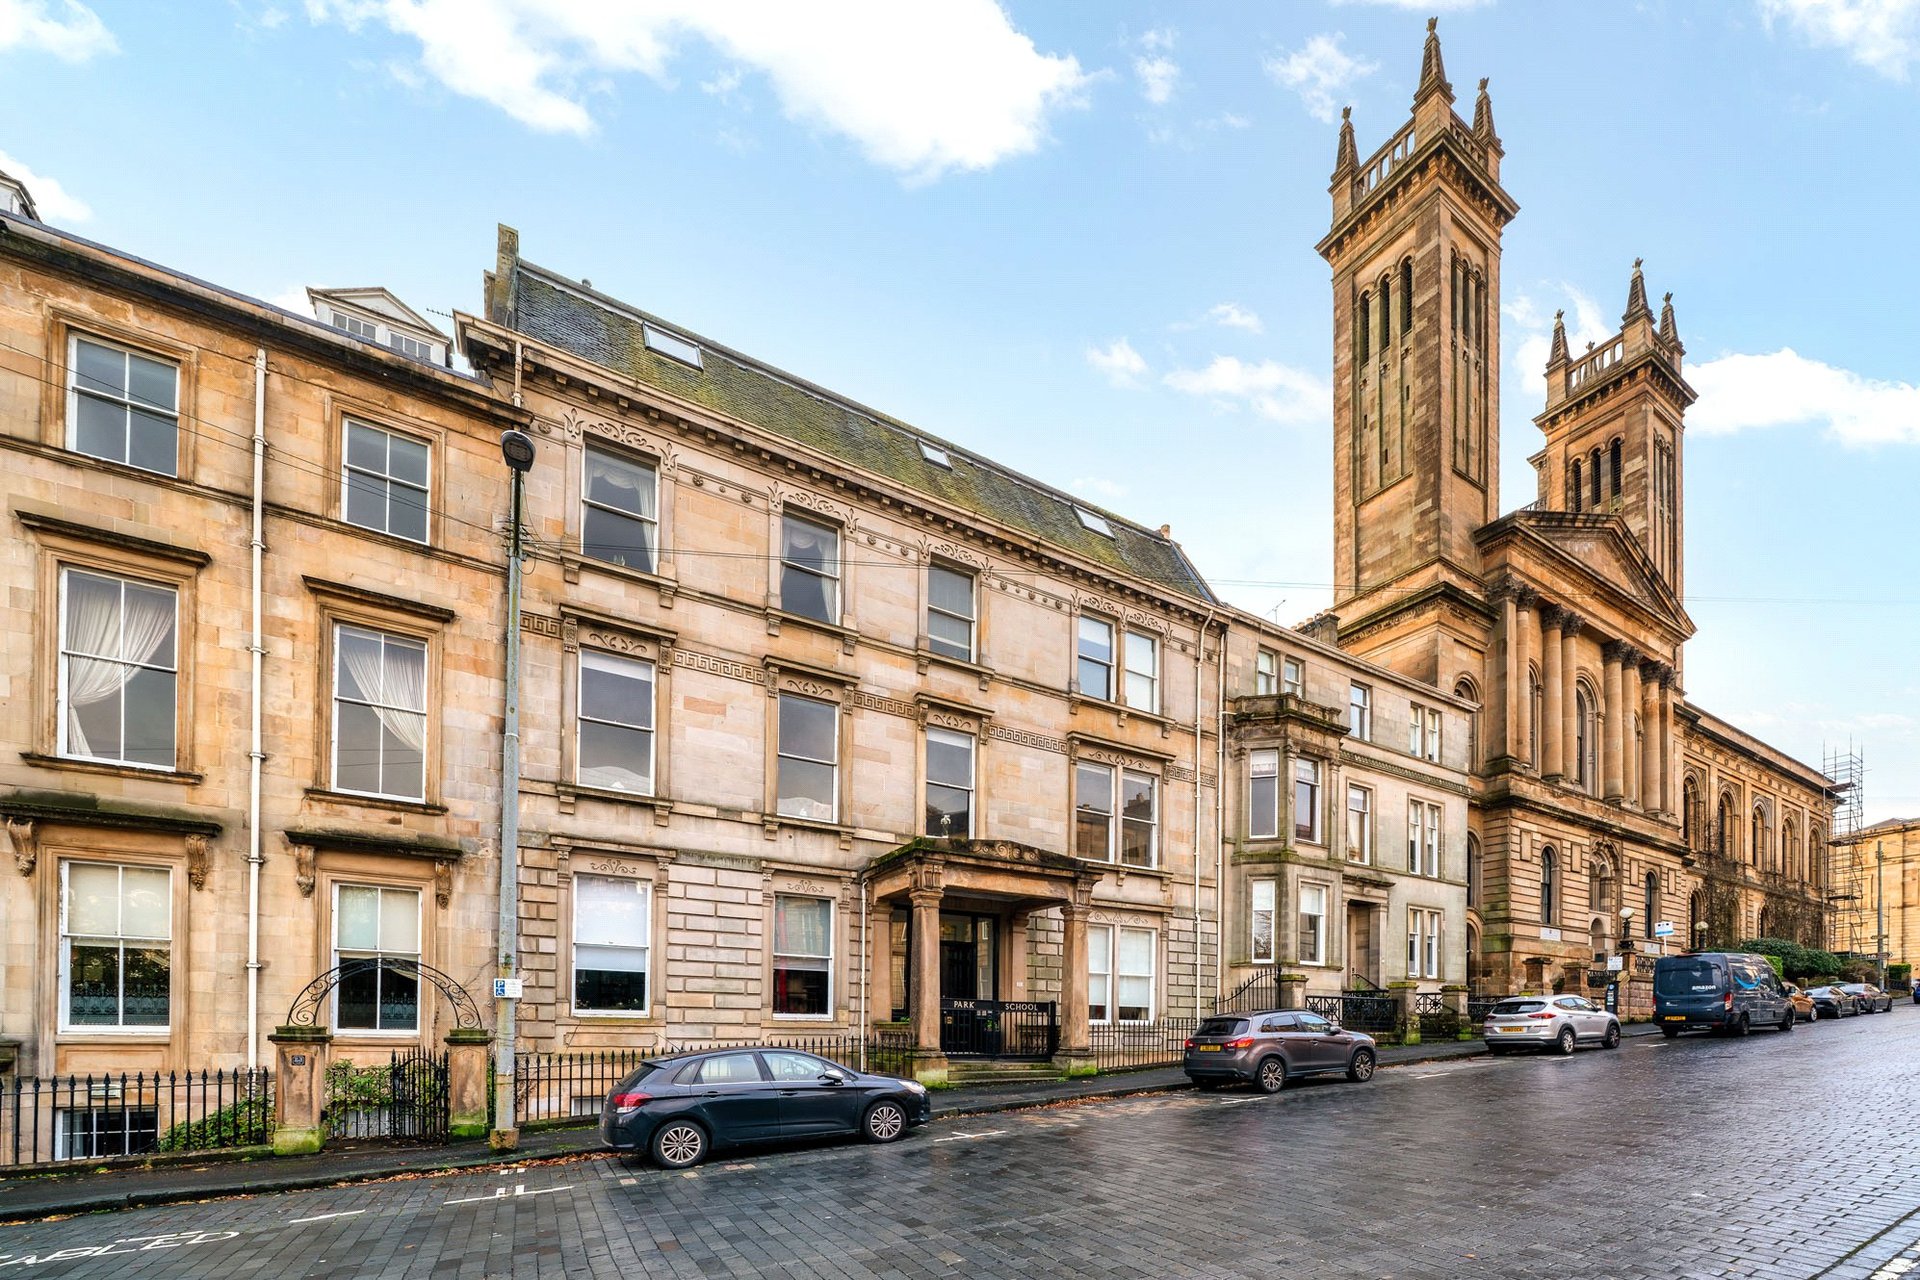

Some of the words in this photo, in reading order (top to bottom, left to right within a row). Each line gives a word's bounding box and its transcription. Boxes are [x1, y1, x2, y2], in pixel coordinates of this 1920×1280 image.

[953, 1000, 976, 1009] PARK
[1005, 1003, 1038, 1011] SCHOOL
[0, 1230, 240, 1266] ABLED
